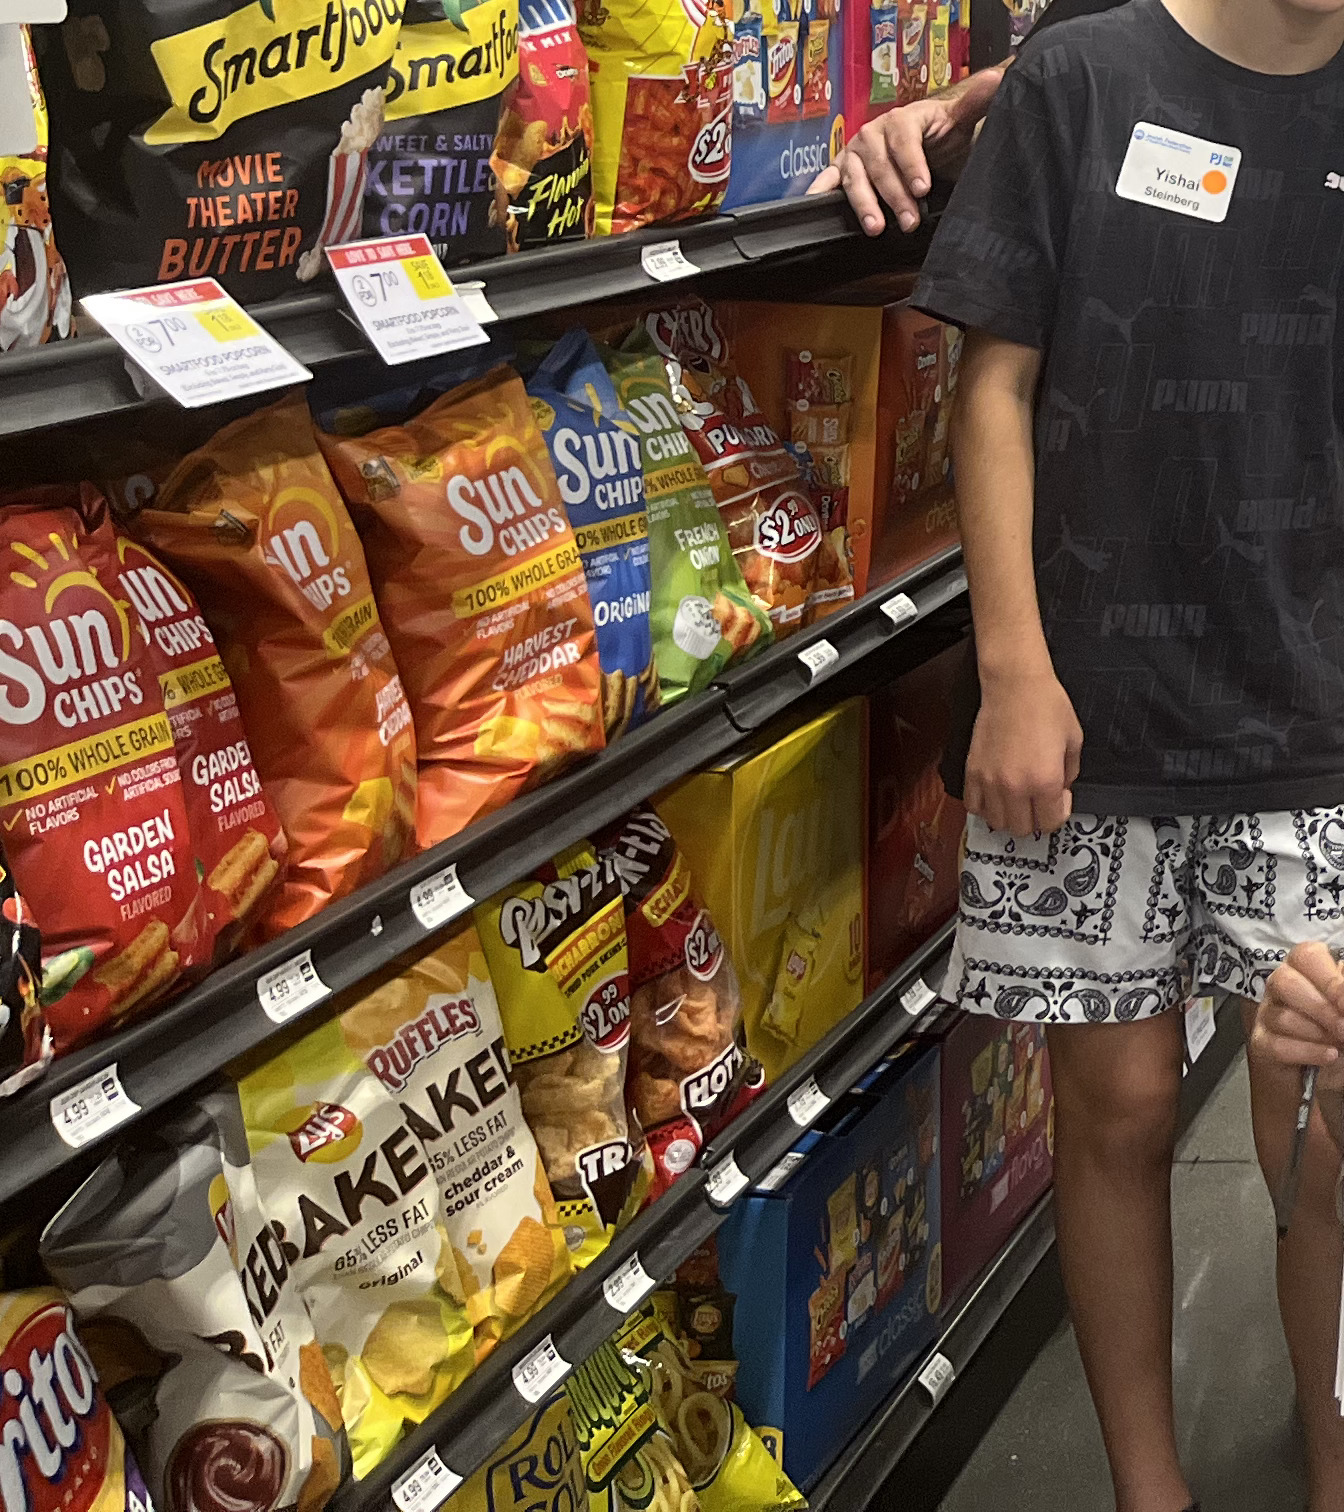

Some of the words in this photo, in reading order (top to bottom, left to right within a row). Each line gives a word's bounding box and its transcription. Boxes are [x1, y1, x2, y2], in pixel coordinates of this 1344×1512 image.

[373, 135, 429, 153] WEET
[436, 135, 447, 151] &
[197, 151, 284, 187] MOVIE
[1156, 168, 1200, 191] Yishai
[187, 189, 299, 227] THEATER
[380, 201, 469, 237] CORN
[1145, 186, 1199, 211] Steinberg
[157, 227, 302, 281] BUTTER
[554, 428, 641, 504] Sun
[447, 464, 542, 555] Sun
[500, 507, 566, 558] CHIPS
[465, 579, 509, 611] 100%
[510, 563, 548, 596] WHOLE
[503, 620, 578, 666] HARVEST
[0, 610, 122, 724] Sun
[494, 642, 580, 692] CHEDDAR
[52, 676, 144, 727] CHIPS
[0, 756, 67, 796] 100%
[68, 735, 127, 775] WHOLE
[129, 720, 169, 754] GRAIN
[24, 805, 43, 819] NO
[46, 786, 98, 815] ARTIFICIAL
[210, 772, 262, 812] SALSA
[29, 809, 79, 835] FLAVORS
[218, 802, 265, 831] FLAVORED
[83, 811, 174, 873] GARDEN
[107, 857, 175, 900] SALSA
[120, 887, 171, 922] FLAVORED
[368, 997, 478, 1091] RUFFLES
[62, 1099, 88, 1126] 4.99
[452, 1130, 483, 1163] LESS
[486, 1112, 508, 1139] FAT
[444, 1160, 500, 1202] cheddar
[446, 1192, 480, 1217] sour
[482, 1159, 524, 1197] cream
[361, 1220, 399, 1258] LESS
[402, 1199, 430, 1228] FAT
